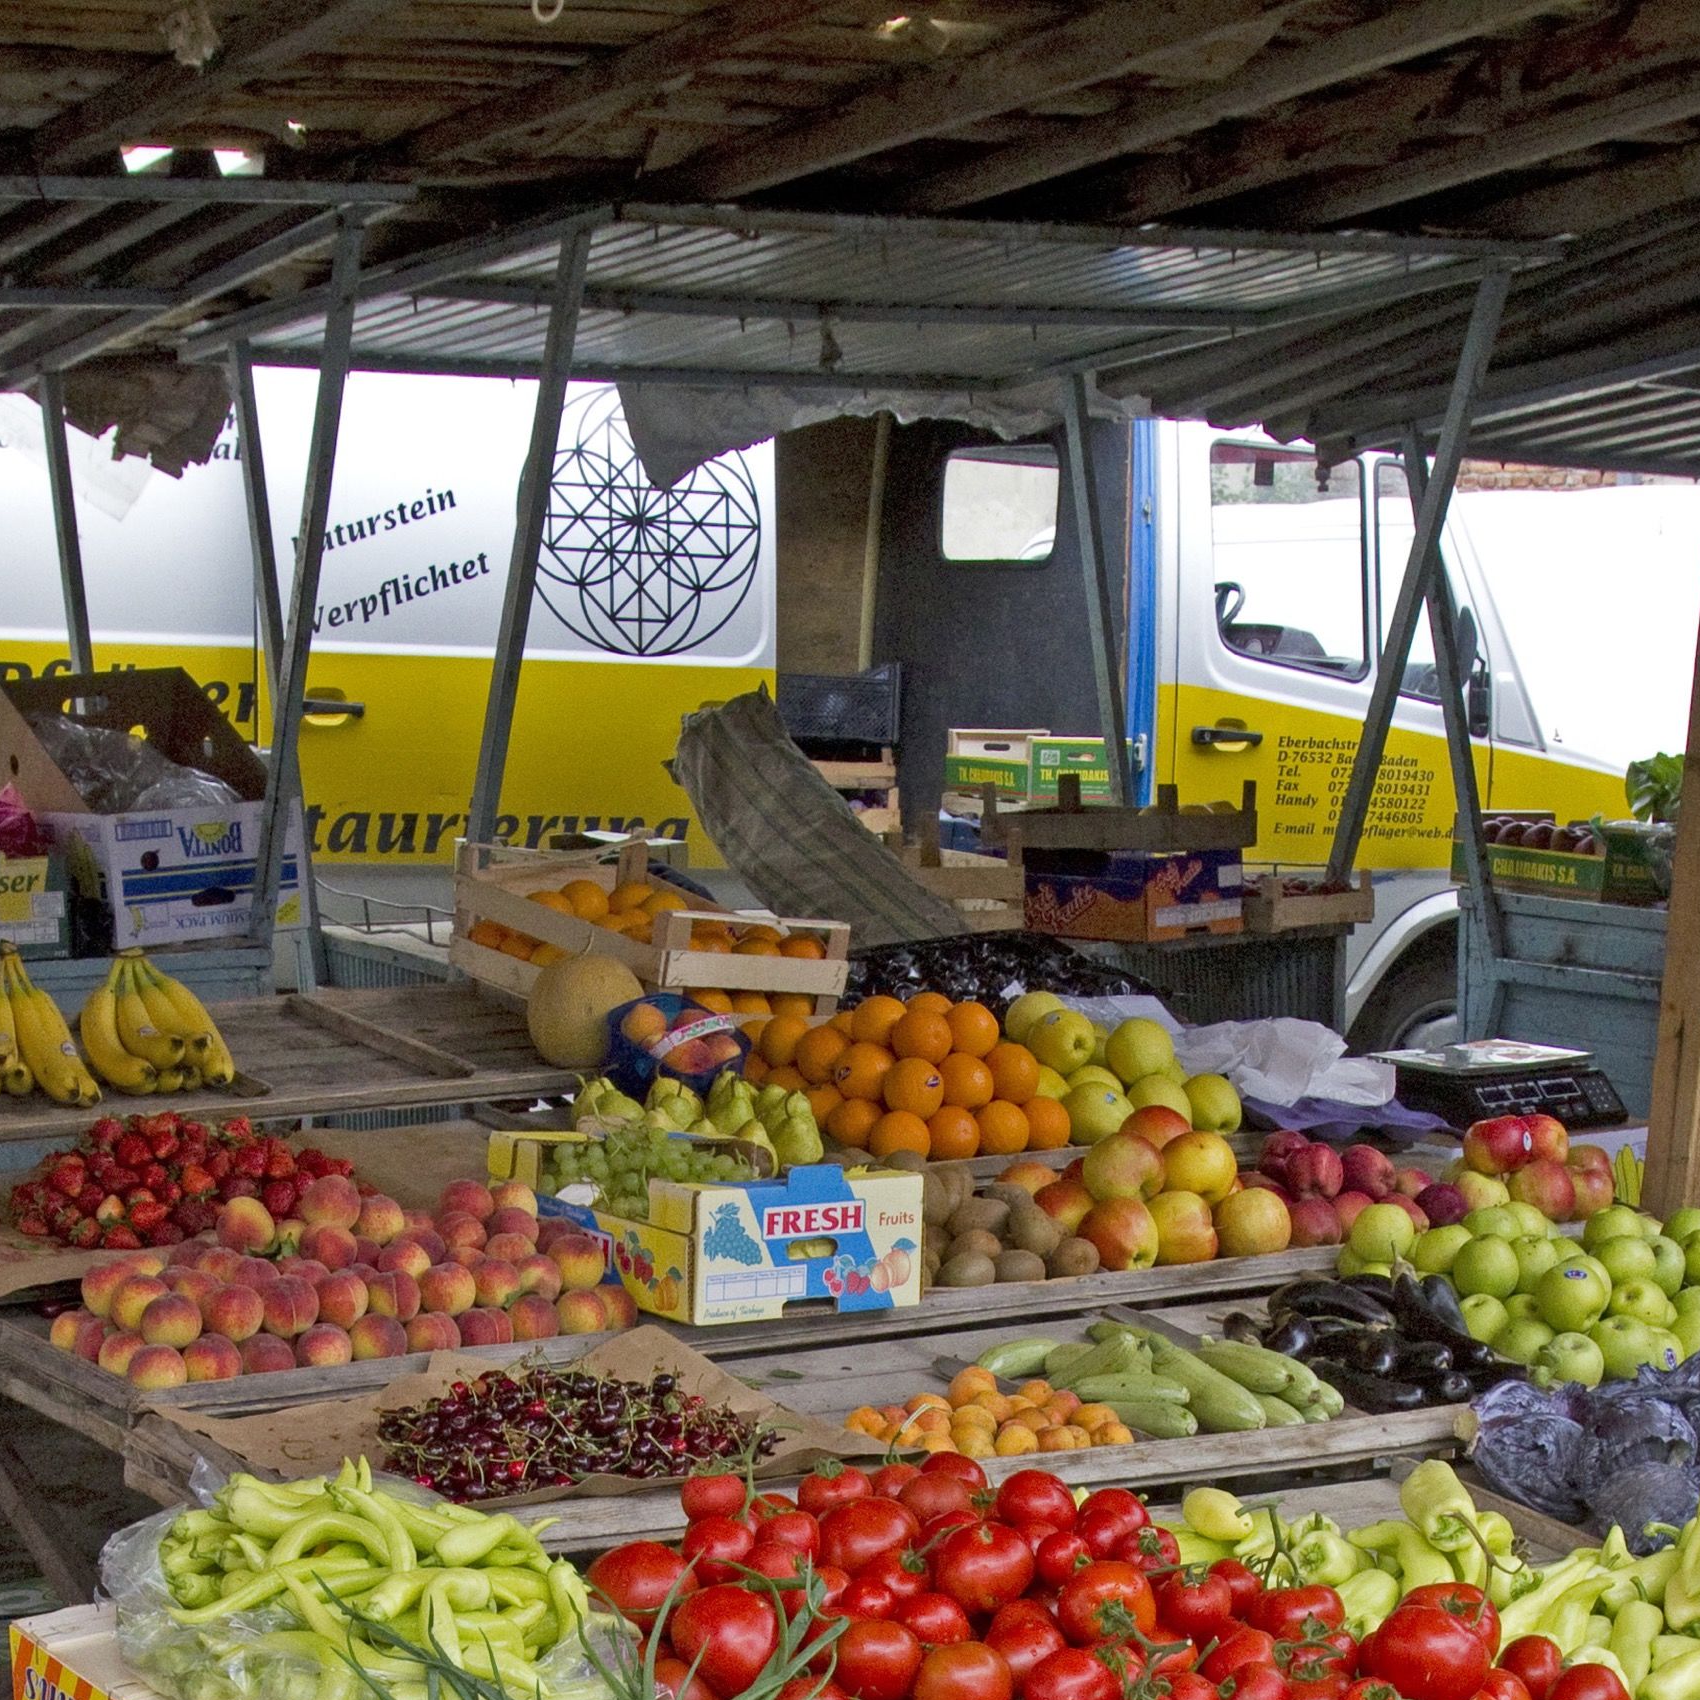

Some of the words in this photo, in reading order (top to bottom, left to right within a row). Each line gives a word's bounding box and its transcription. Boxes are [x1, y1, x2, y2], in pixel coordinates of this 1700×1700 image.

[291, 488, 457, 553] aturstein
[1278, 765, 1301, 778] Tel.
[1276, 780, 1299, 791] Fax
[1275, 794, 1319, 808] Handy
[765, 1204, 863, 1237] FRESH
[878, 1211, 916, 1227] Fruits
